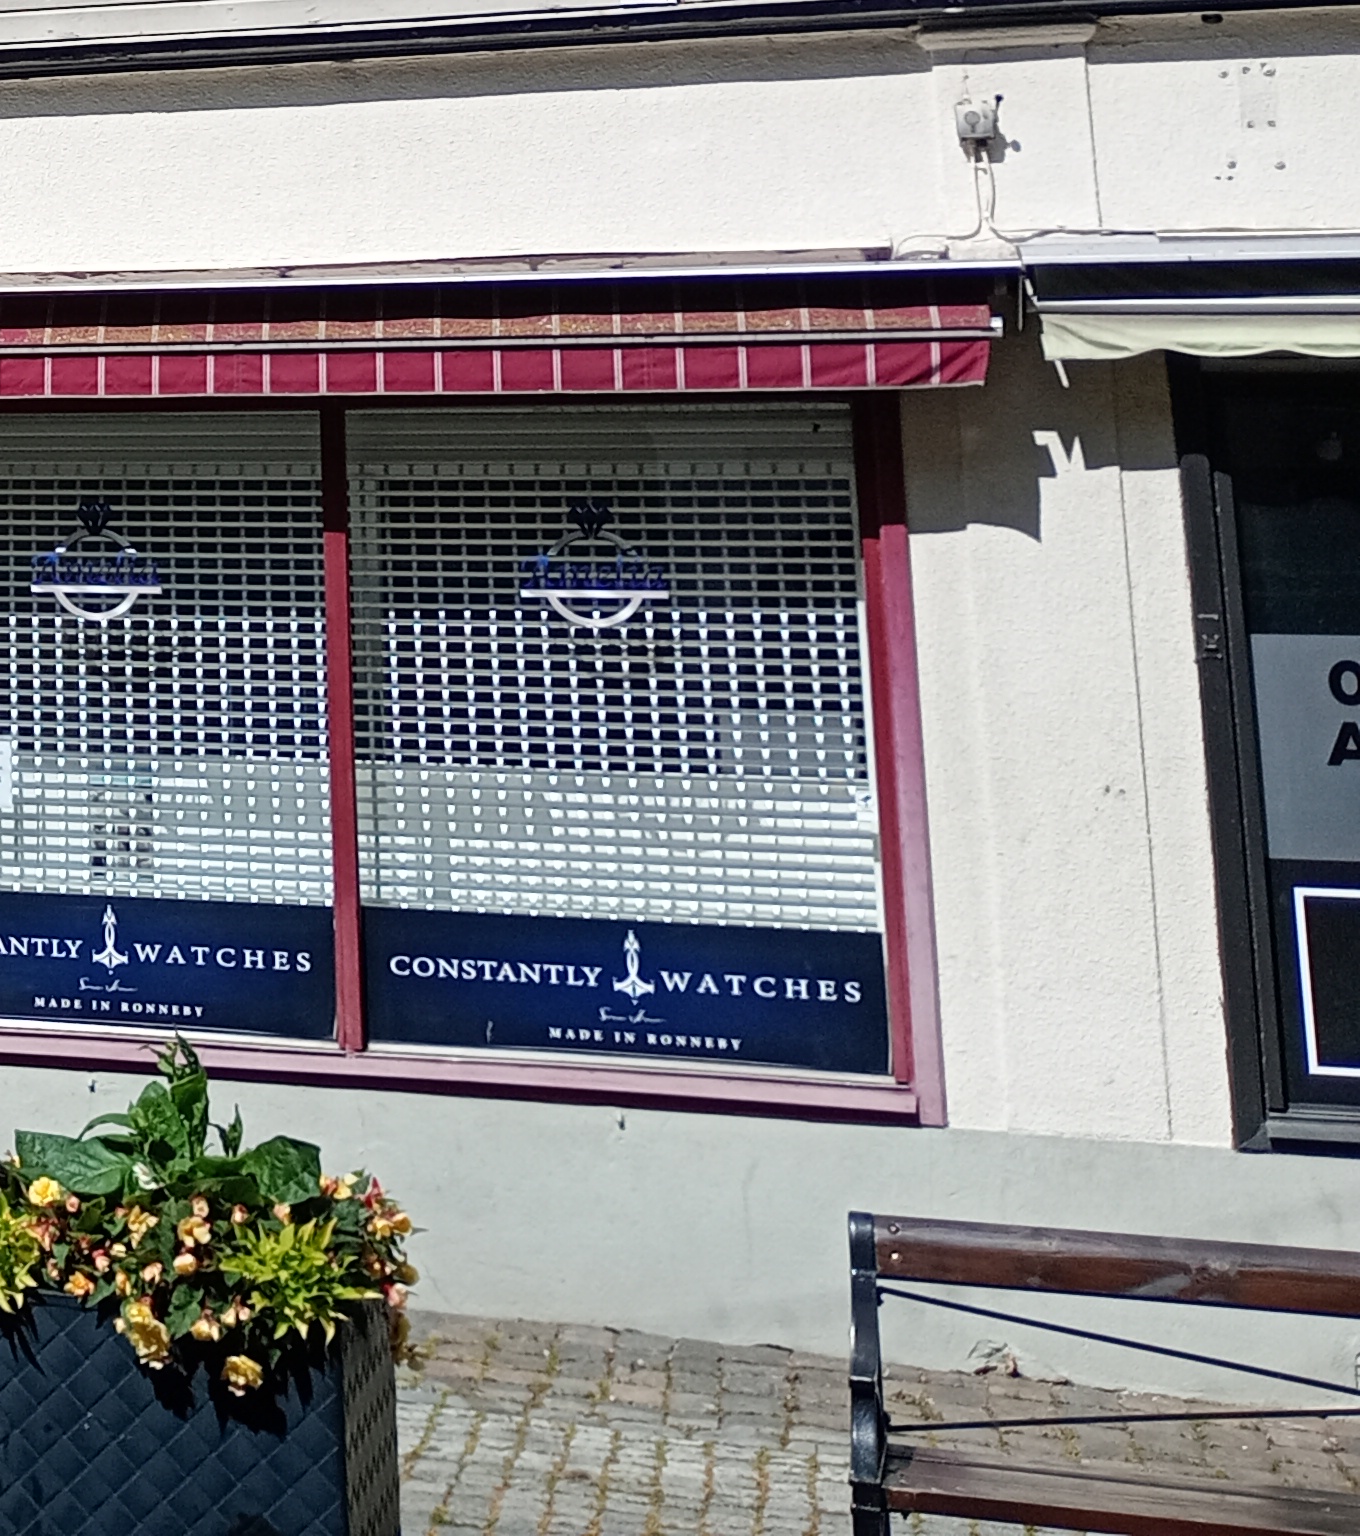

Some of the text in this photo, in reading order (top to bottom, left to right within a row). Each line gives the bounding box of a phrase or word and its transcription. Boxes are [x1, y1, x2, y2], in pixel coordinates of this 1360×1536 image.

[133, 943, 312, 972] WATCHES
[389, 955, 863, 1003] CONSTANTLY WATCHES
[33, 996, 204, 1018] MADE IN RONNEBY
[548, 1026, 743, 1052] MADE IN RONNEBY
